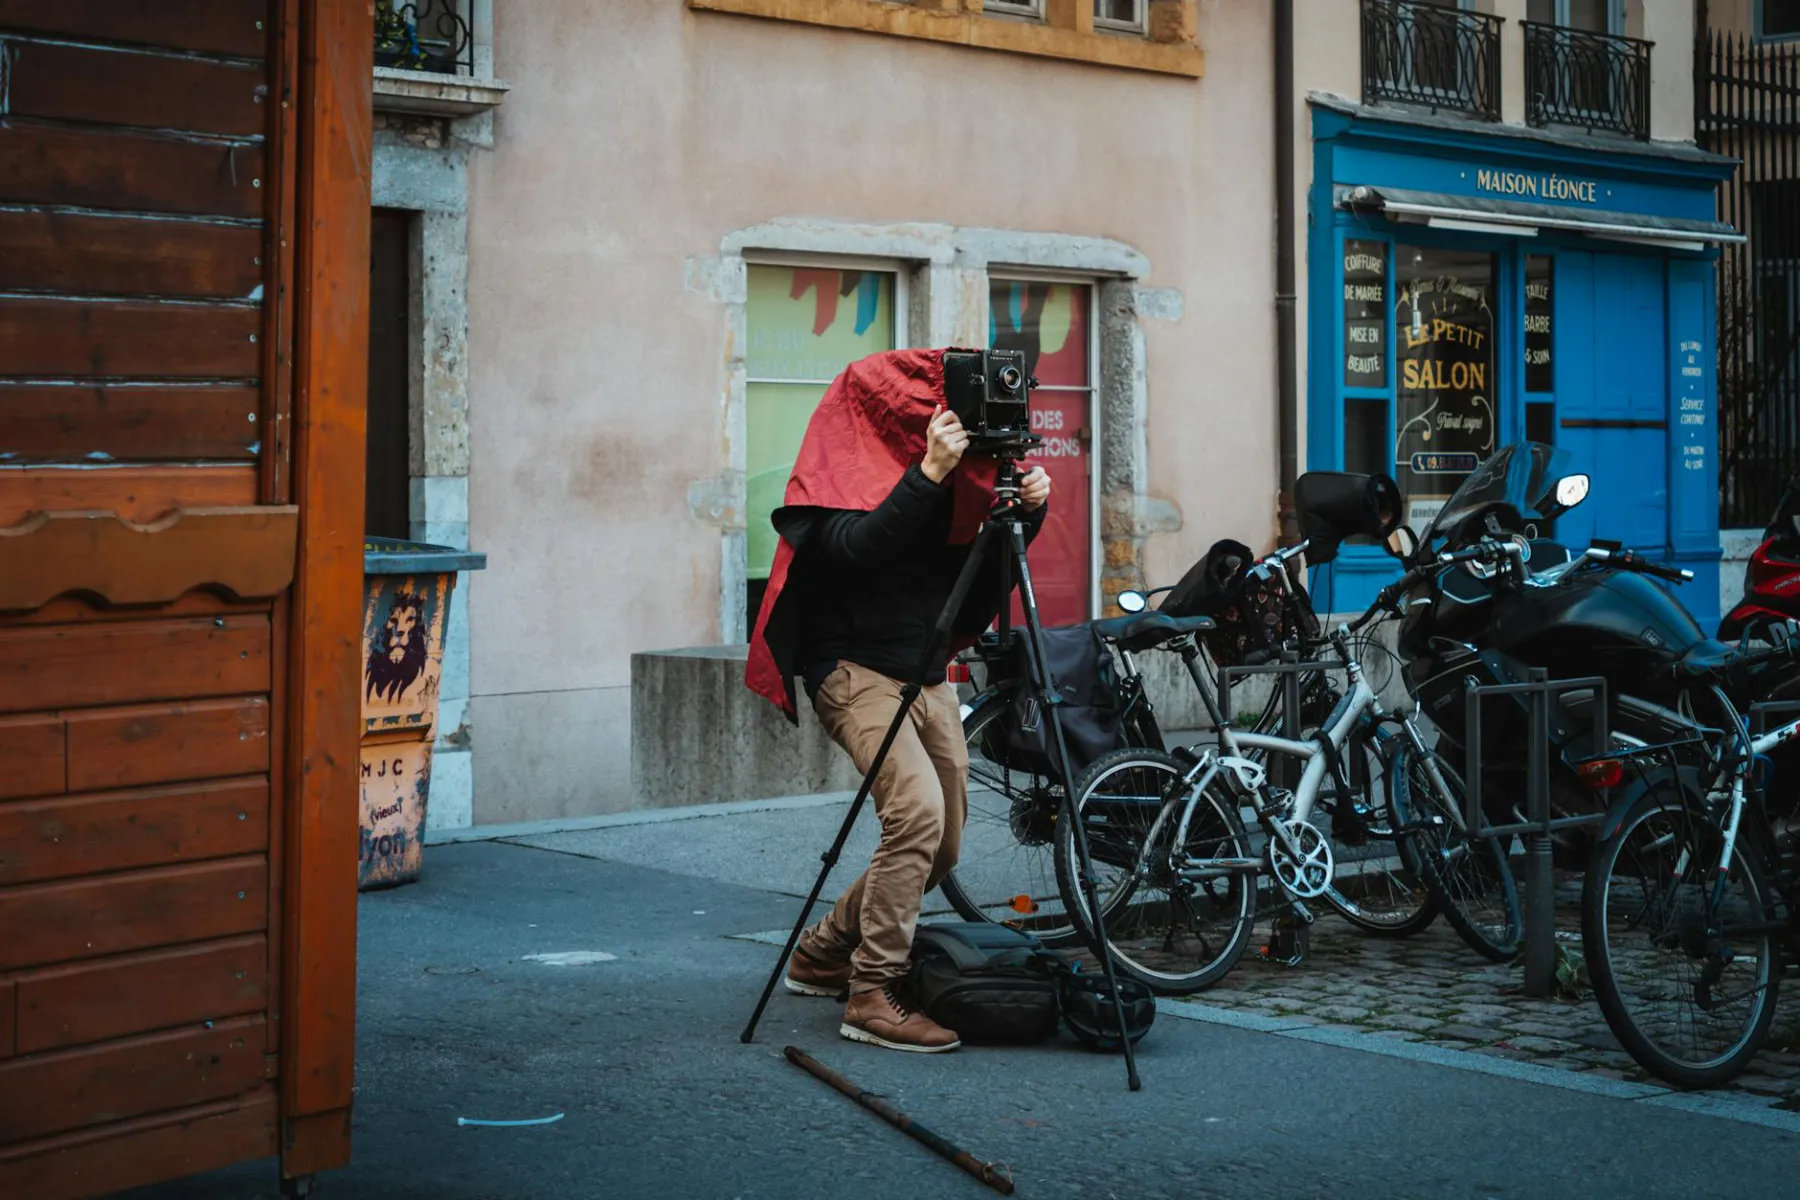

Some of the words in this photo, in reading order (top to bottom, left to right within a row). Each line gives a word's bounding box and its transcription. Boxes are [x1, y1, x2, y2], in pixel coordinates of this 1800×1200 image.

[1477, 168, 1537, 197] MAISON
[1541, 173, 1597, 202] LÉONCE
[1344, 254, 1382, 274] COIFFURE
[1344, 284, 1354, 300] DE
[1355, 283, 1383, 302] MARIÉE
[1526, 284, 1549, 301] TAILLE
[1524, 315, 1550, 333] BARBE
[1349, 326, 1368, 342] MISE
[1369, 327, 1379, 343] EN
[1433, 318, 1484, 350] PETIT
[1347, 354, 1380, 373] BEAUTÉ
[1533, 349, 1550, 364] SOIN
[1403, 358, 1485, 390] SALON
[1032, 410, 1064, 430] DES
